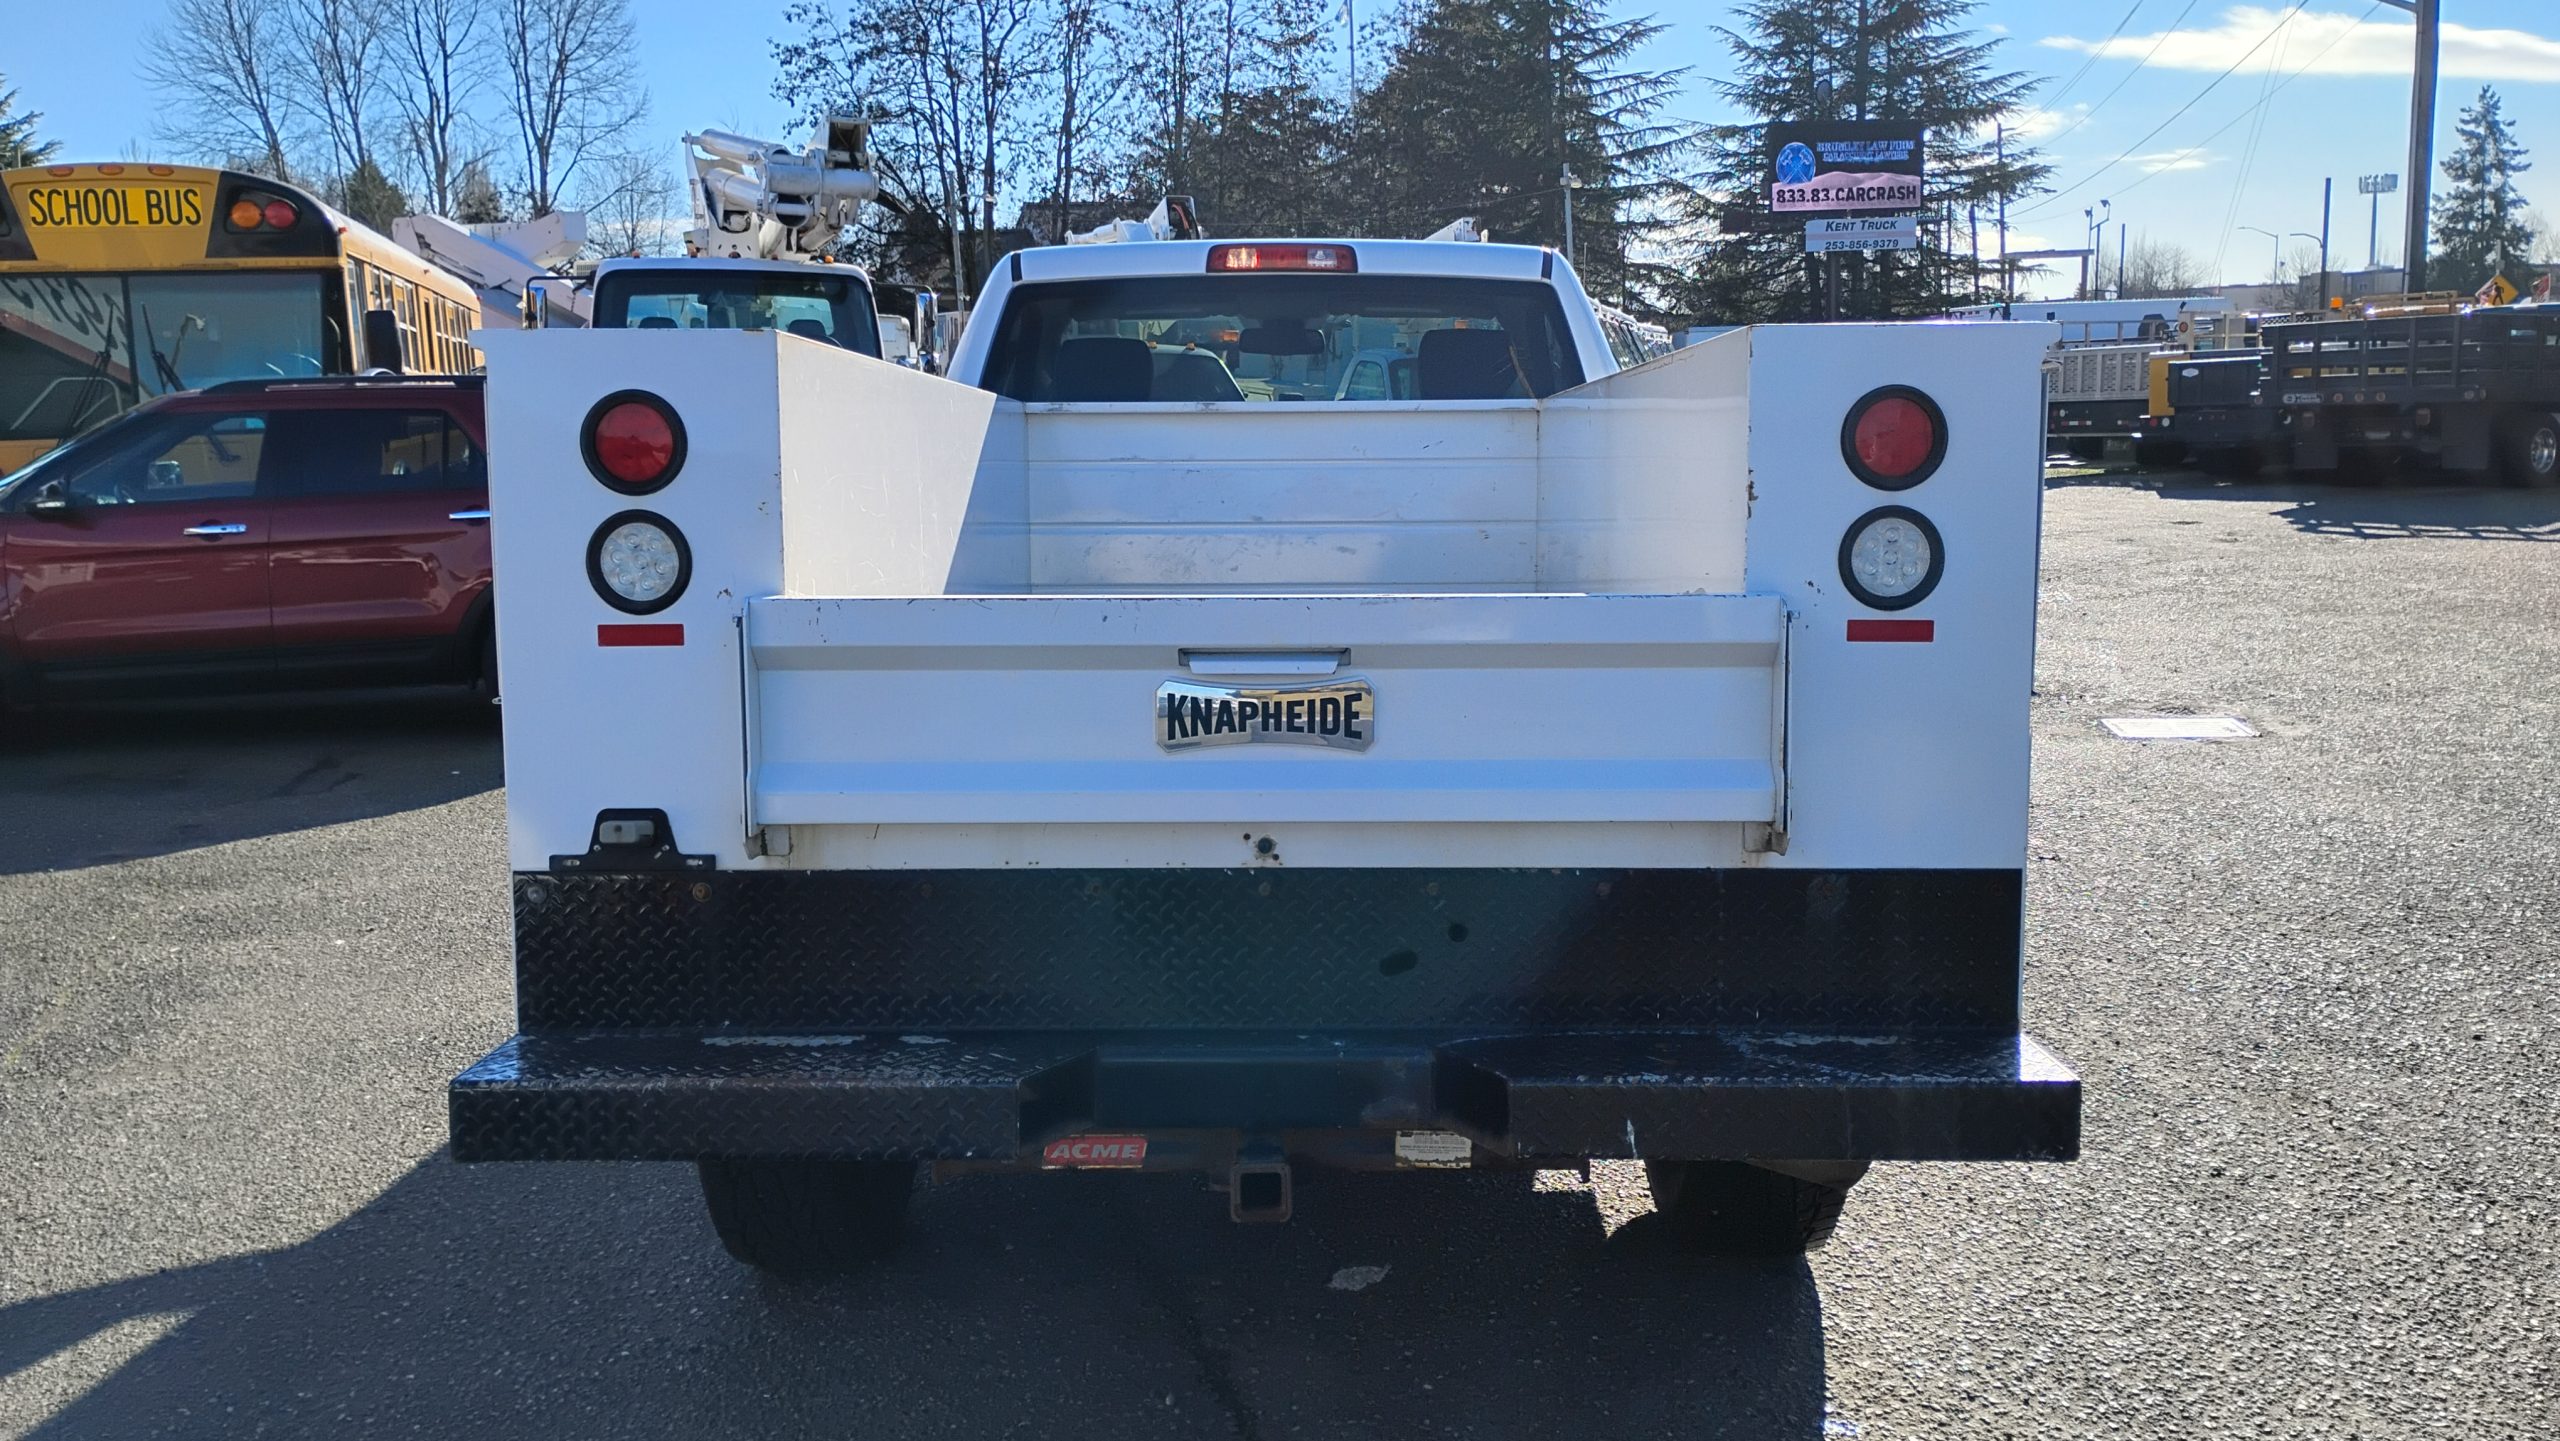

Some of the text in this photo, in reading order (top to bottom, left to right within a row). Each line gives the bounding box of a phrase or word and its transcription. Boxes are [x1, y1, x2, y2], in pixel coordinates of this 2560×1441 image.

[1866, 140, 1888, 151] LAW
[1776, 186, 1917, 203] 833.83.CARCRASH
[28, 188, 202, 227] SCHOOL BUS
[1825, 239, 1899, 251] 253-856-9379
[1166, 692, 1363, 741] KNAPHEIDE
[1050, 1143, 1140, 1159] ACME
